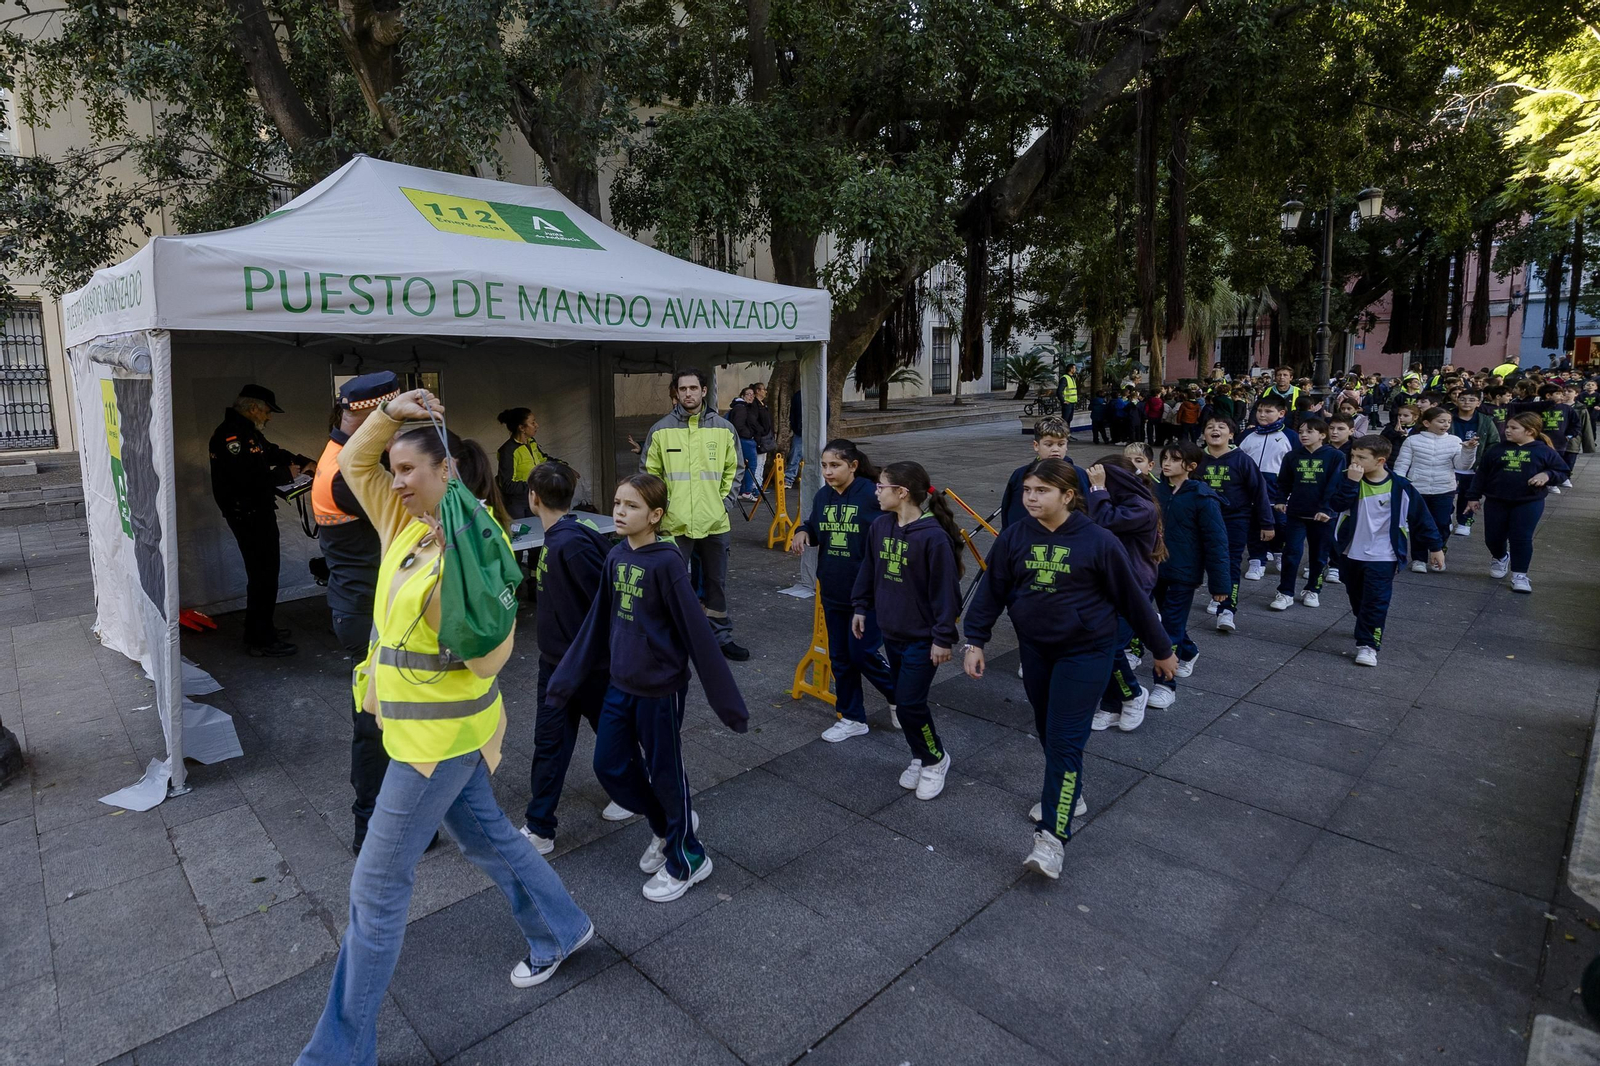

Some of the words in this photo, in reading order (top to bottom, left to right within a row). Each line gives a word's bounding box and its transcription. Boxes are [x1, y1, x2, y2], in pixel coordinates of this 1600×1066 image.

[423, 202, 497, 224] 112
[435, 216, 506, 232] Emergencias
[104, 270, 142, 314] AVANZADO
[243, 266, 436, 317] PUESTO
[452, 279, 506, 320] DE
[517, 285, 651, 328] MANDO
[660, 298, 798, 330] AVANZADO
[819, 522, 860, 533] VEDRUNA
[1025, 560, 1071, 574] VEDRUNA
